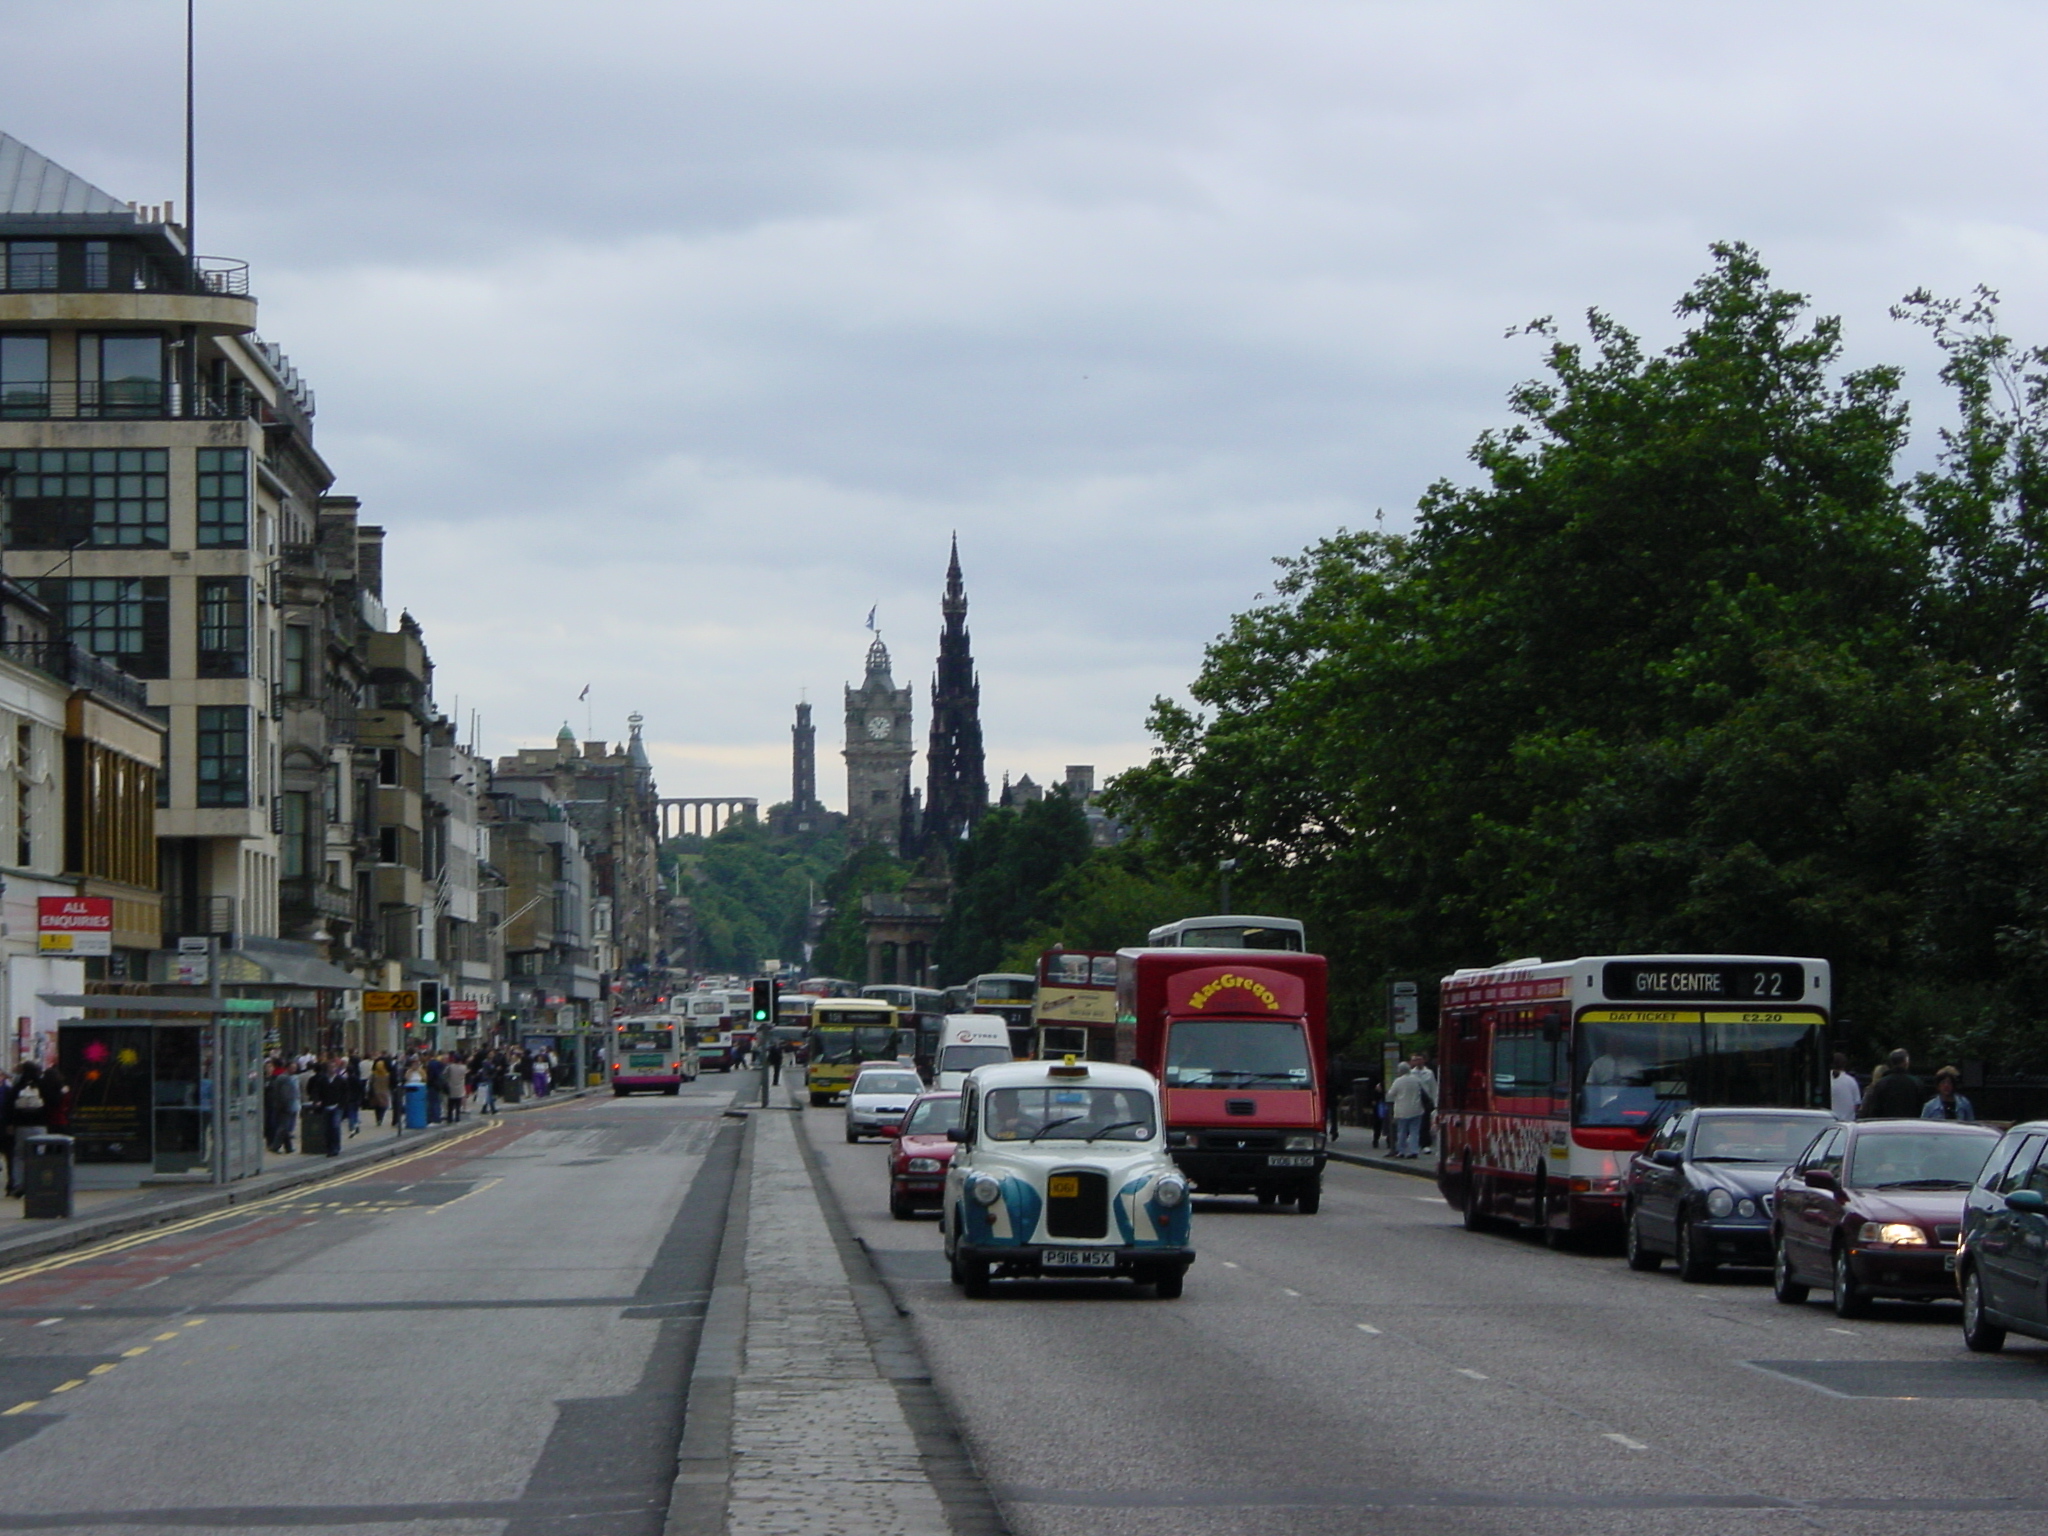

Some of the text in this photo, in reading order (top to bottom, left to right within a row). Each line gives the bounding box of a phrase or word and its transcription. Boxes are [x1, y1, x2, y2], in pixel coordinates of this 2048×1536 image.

[63, 902, 88, 913] ALL
[41, 915, 110, 928] ENQUIRIES
[1636, 972, 1782, 995] GYLE CENTRE 22
[1188, 973, 1280, 1010] MacGregor
[391, 994, 414, 1008] 20
[1609, 1012, 1677, 1021] DAY TICKET
[1742, 1013, 1783, 1022] £2.20
[1047, 1252, 1110, 1265] P916 MSX
